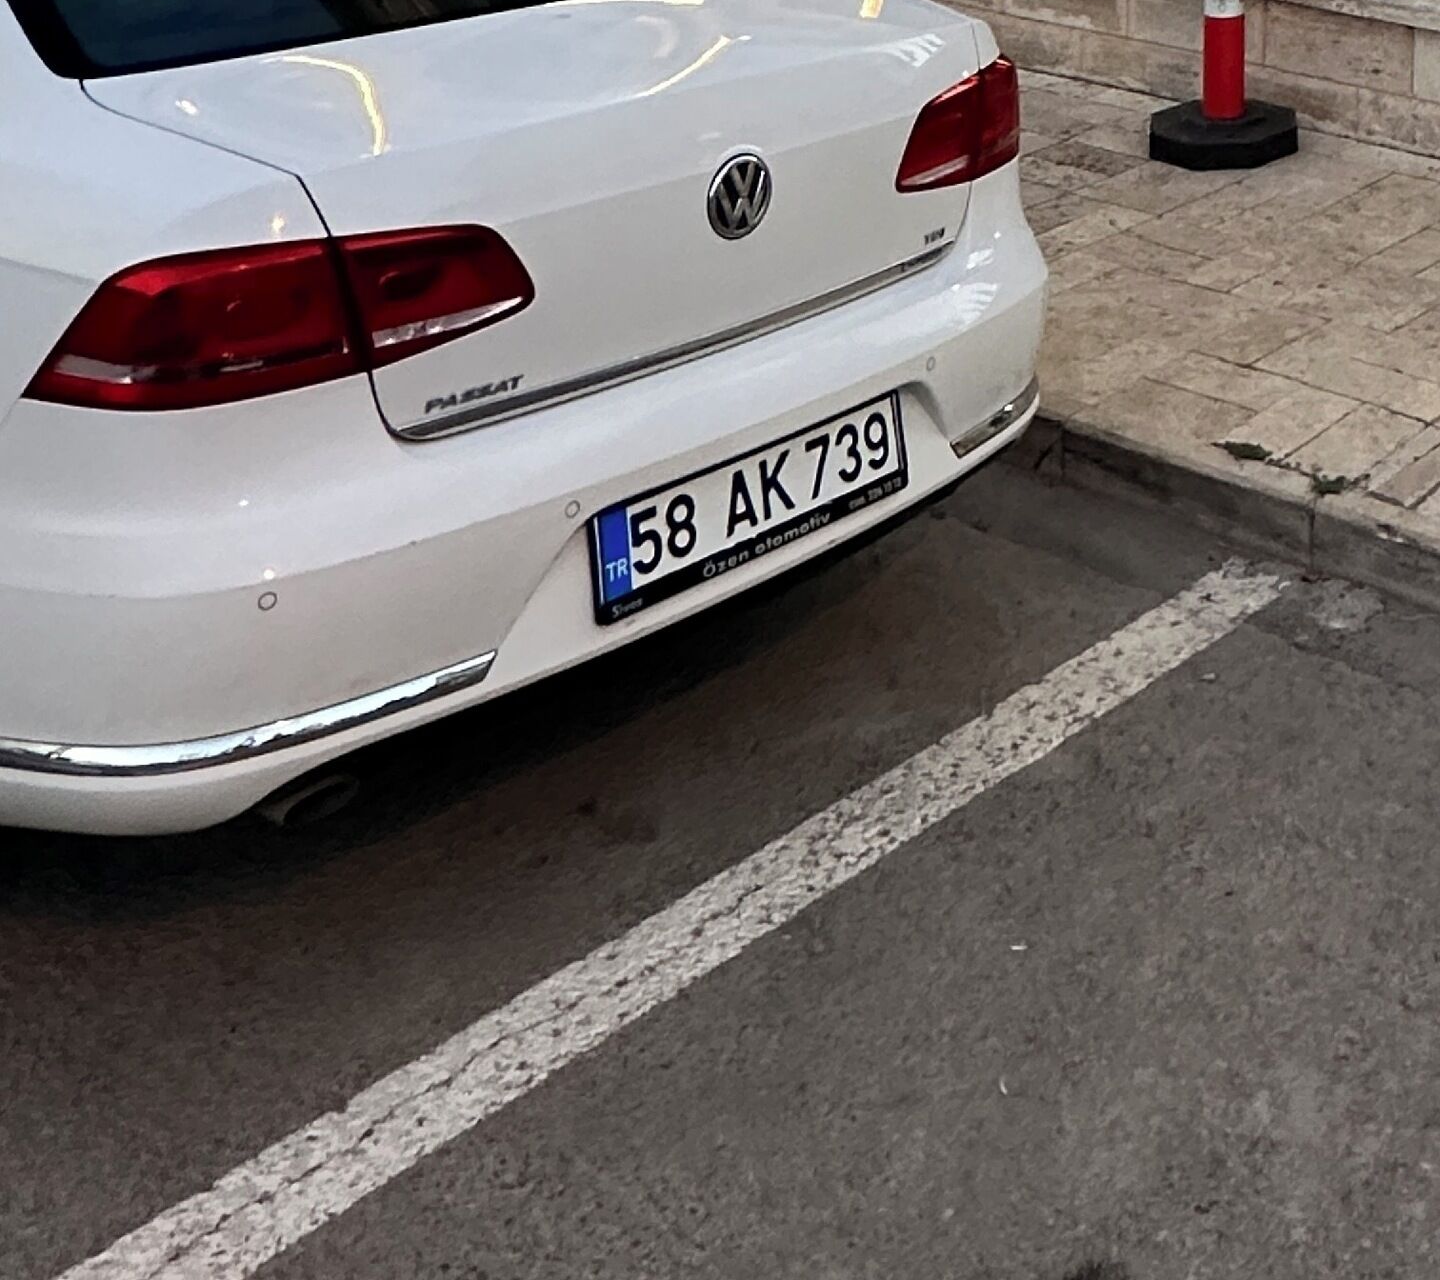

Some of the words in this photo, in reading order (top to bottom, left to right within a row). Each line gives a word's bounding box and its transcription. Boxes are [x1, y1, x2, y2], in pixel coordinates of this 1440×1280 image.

[424, 374, 524, 415] PASSAT
[629, 493, 697, 575] 58
[726, 448, 796, 539] AK
[805, 411, 890, 500] 739
[605, 557, 629, 583] TR
